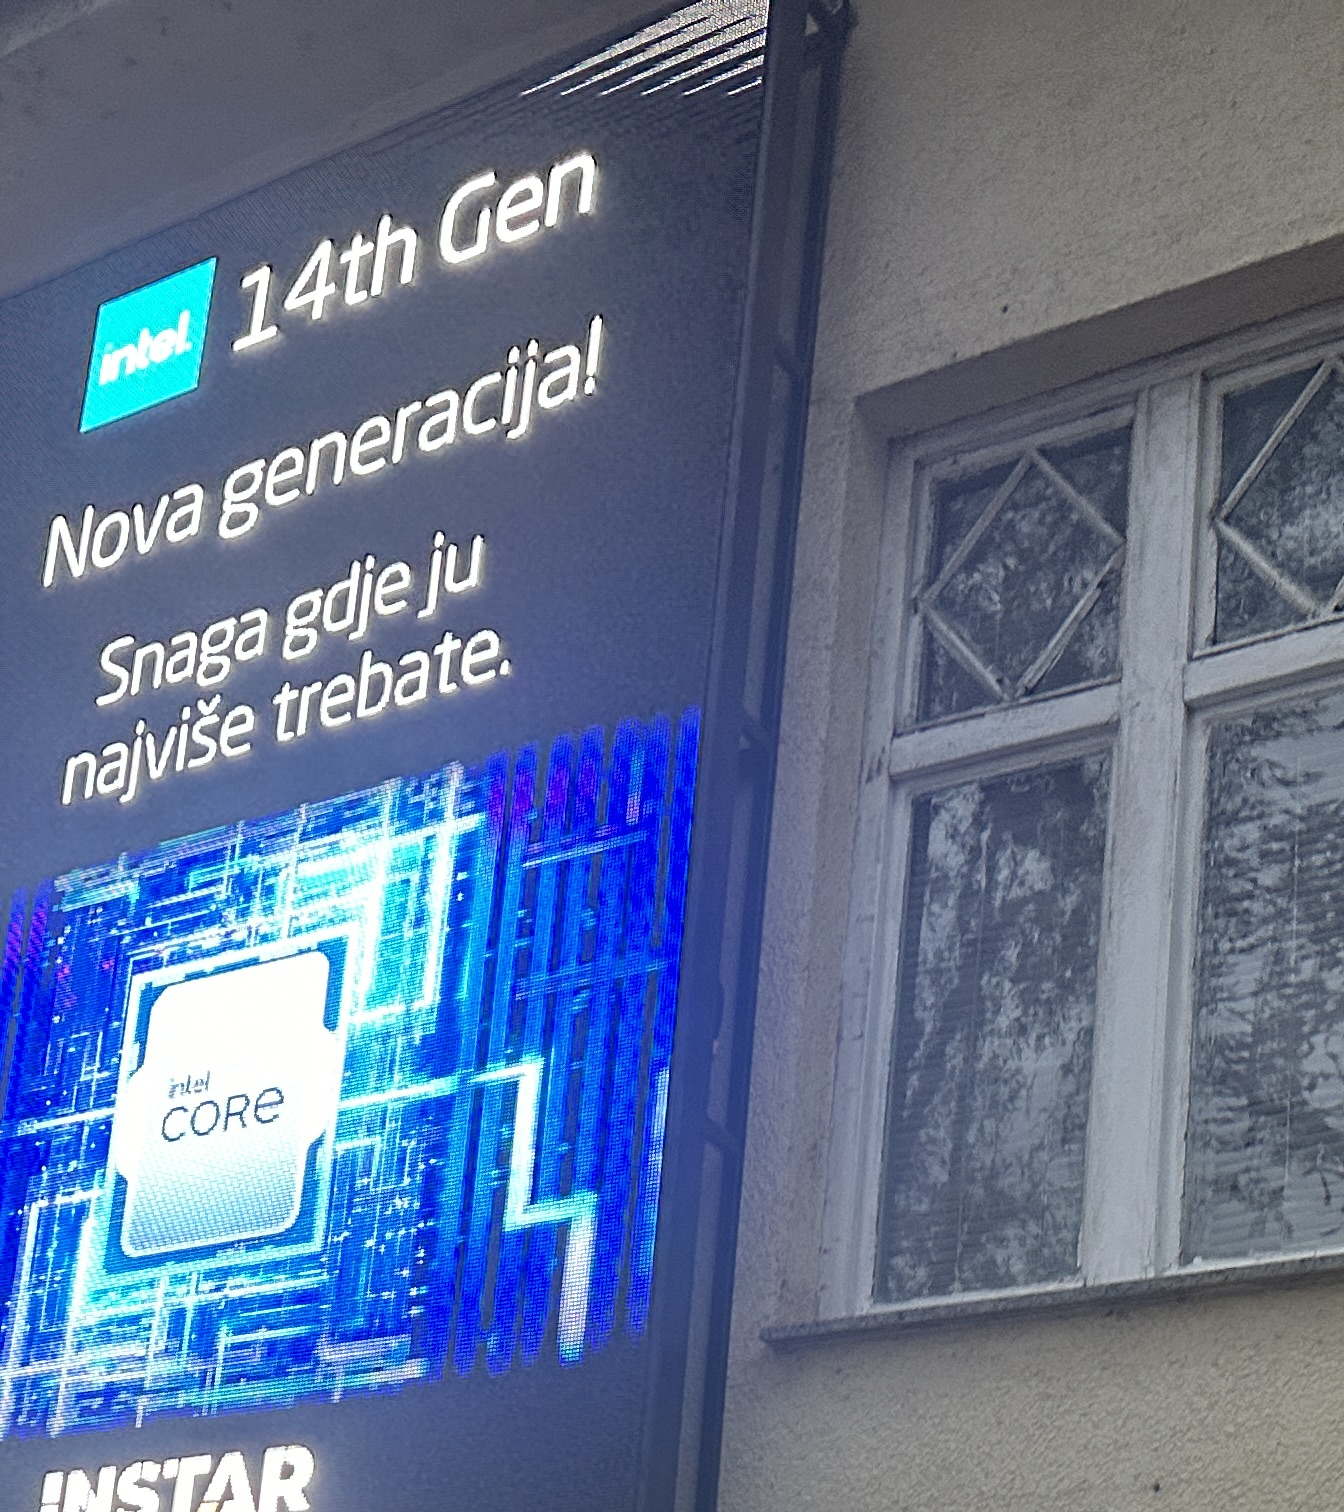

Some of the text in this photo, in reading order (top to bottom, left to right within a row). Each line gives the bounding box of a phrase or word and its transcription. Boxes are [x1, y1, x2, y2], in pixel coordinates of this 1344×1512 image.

[231, 150, 600, 351] 14th Gen
[42, 314, 604, 588] Nova generacija!
[95, 532, 485, 706] Snaga gdje ju
[60, 626, 513, 805] najviše trebate.
[167, 1069, 210, 1099] intel
